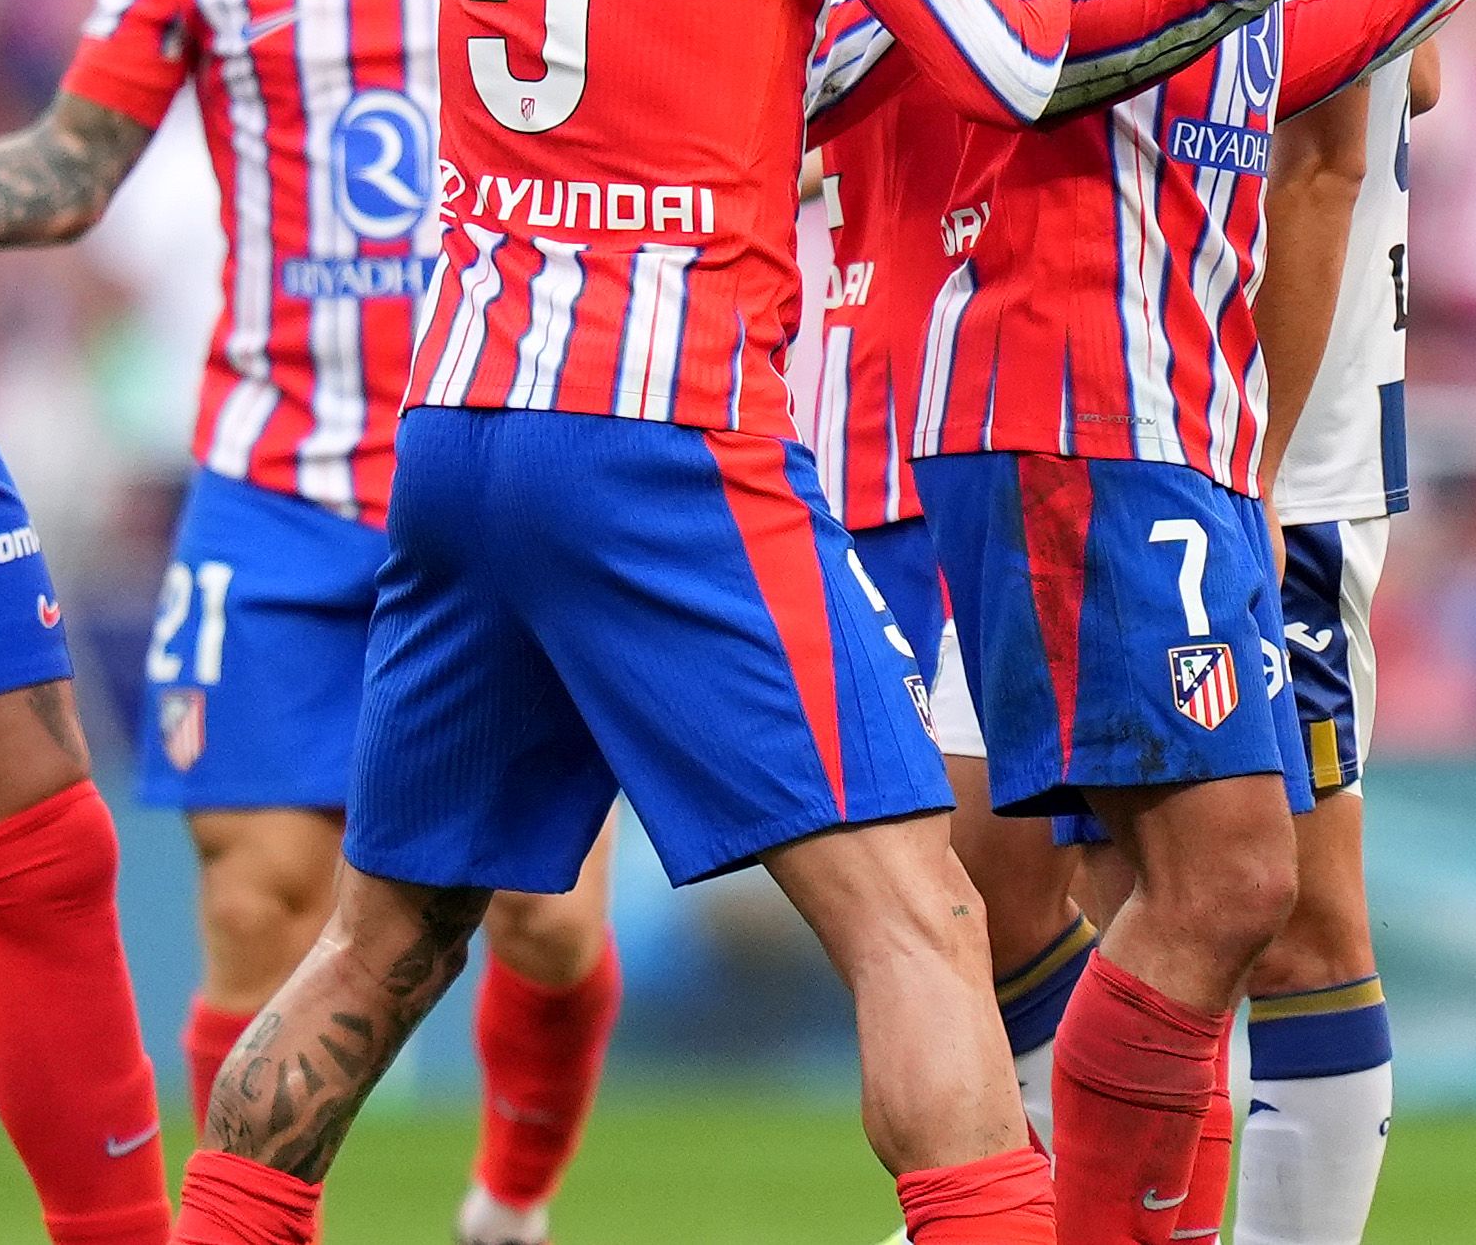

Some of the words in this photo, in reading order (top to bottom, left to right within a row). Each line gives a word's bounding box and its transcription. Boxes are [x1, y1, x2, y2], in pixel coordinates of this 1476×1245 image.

[1174, 122, 1268, 172] RIYADH
[145, 560, 234, 686] 21
[1149, 519, 1209, 637] 7
